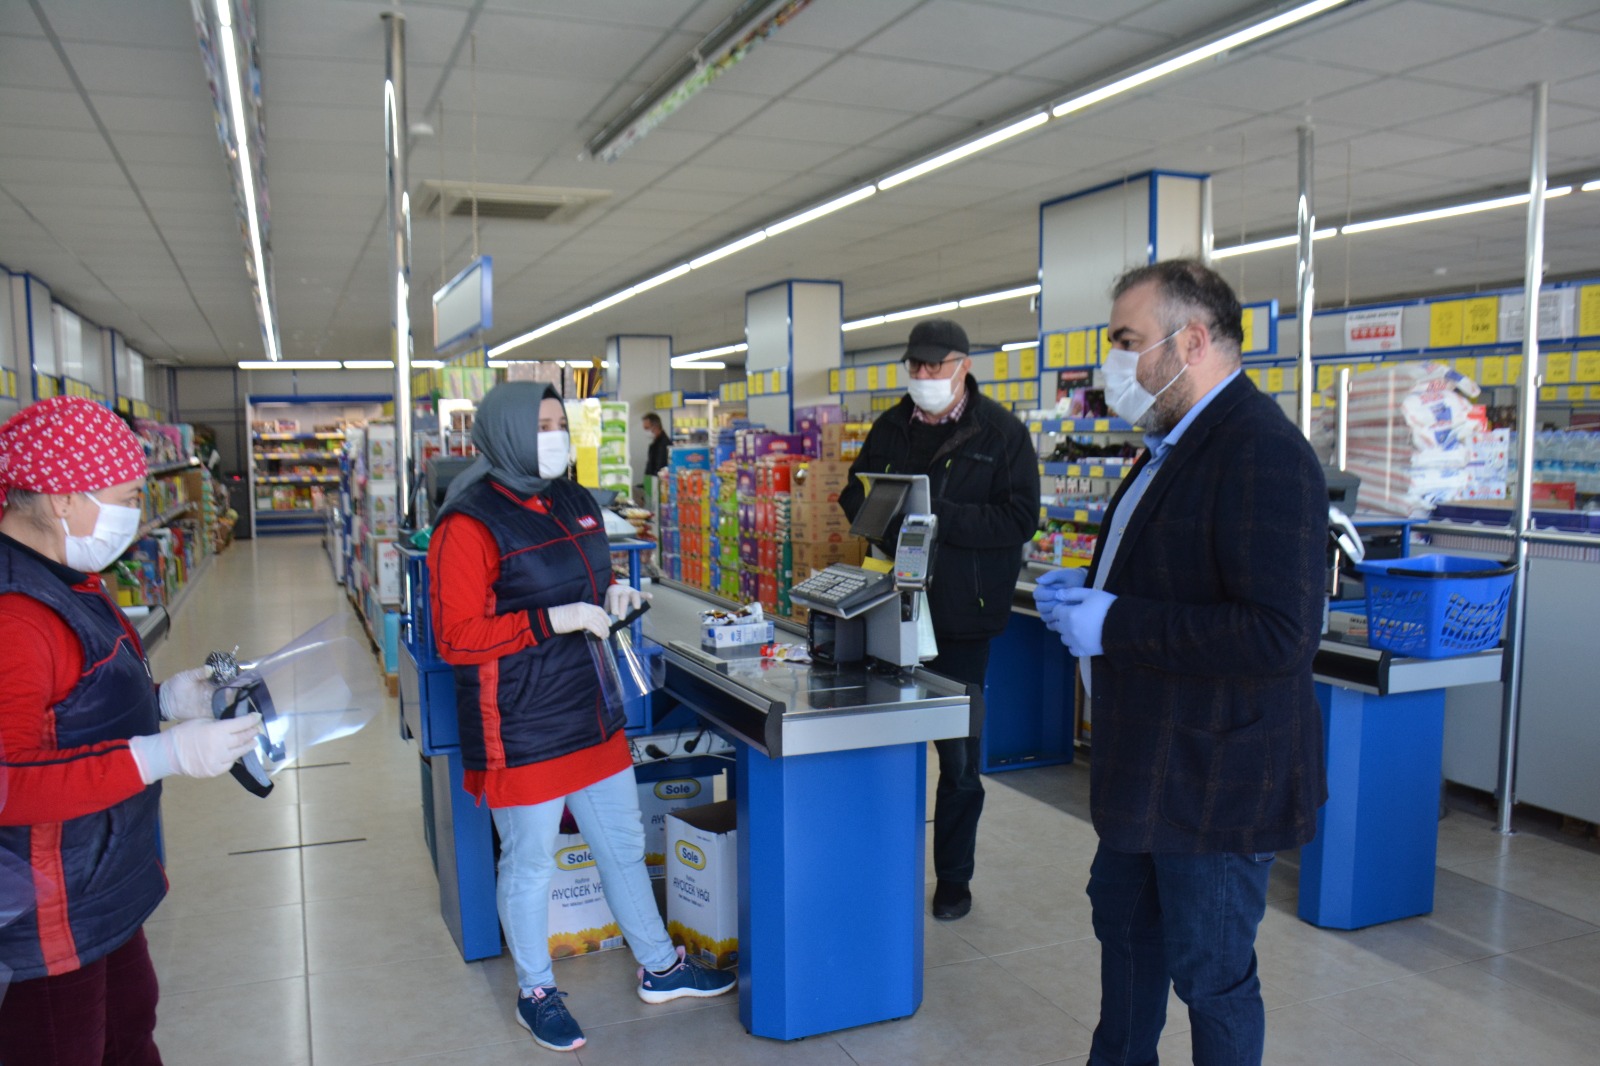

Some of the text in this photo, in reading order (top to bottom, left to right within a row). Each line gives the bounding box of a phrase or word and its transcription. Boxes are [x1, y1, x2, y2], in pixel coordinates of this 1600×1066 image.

[665, 784, 690, 794] Sole
[567, 851, 594, 865] Sole
[682, 847, 699, 863] Sole
